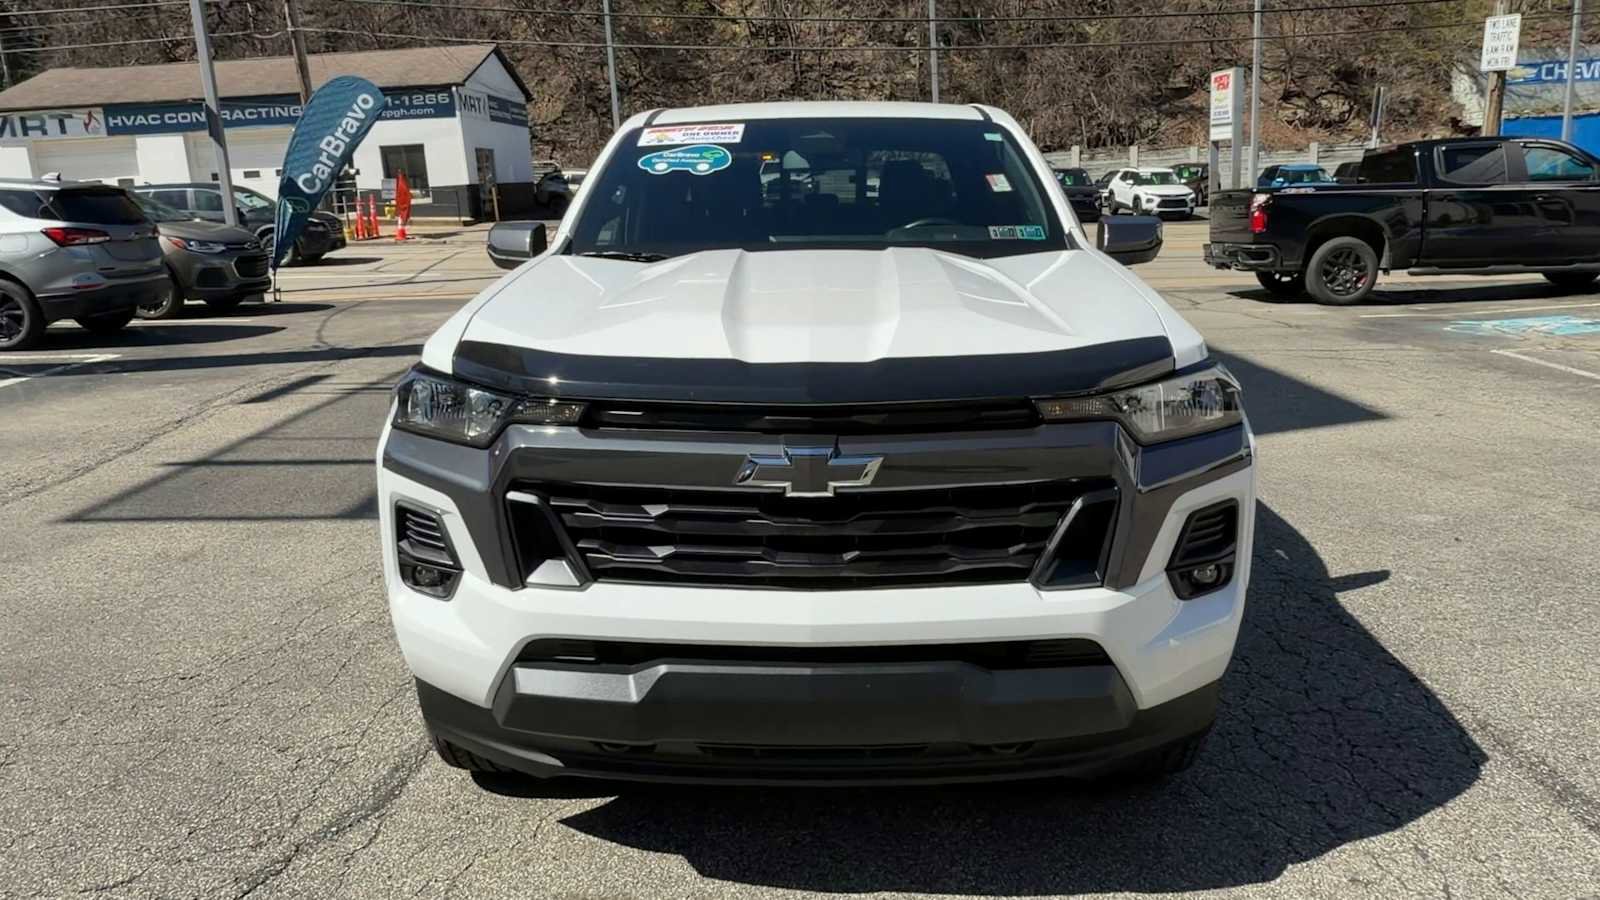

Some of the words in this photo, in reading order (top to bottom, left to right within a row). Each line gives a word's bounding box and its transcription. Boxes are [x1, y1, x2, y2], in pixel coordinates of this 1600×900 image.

[108, 113, 161, 127] HVAC
[164, 105, 304, 124] CONRACTING
[297, 93, 375, 194] CarBravo
